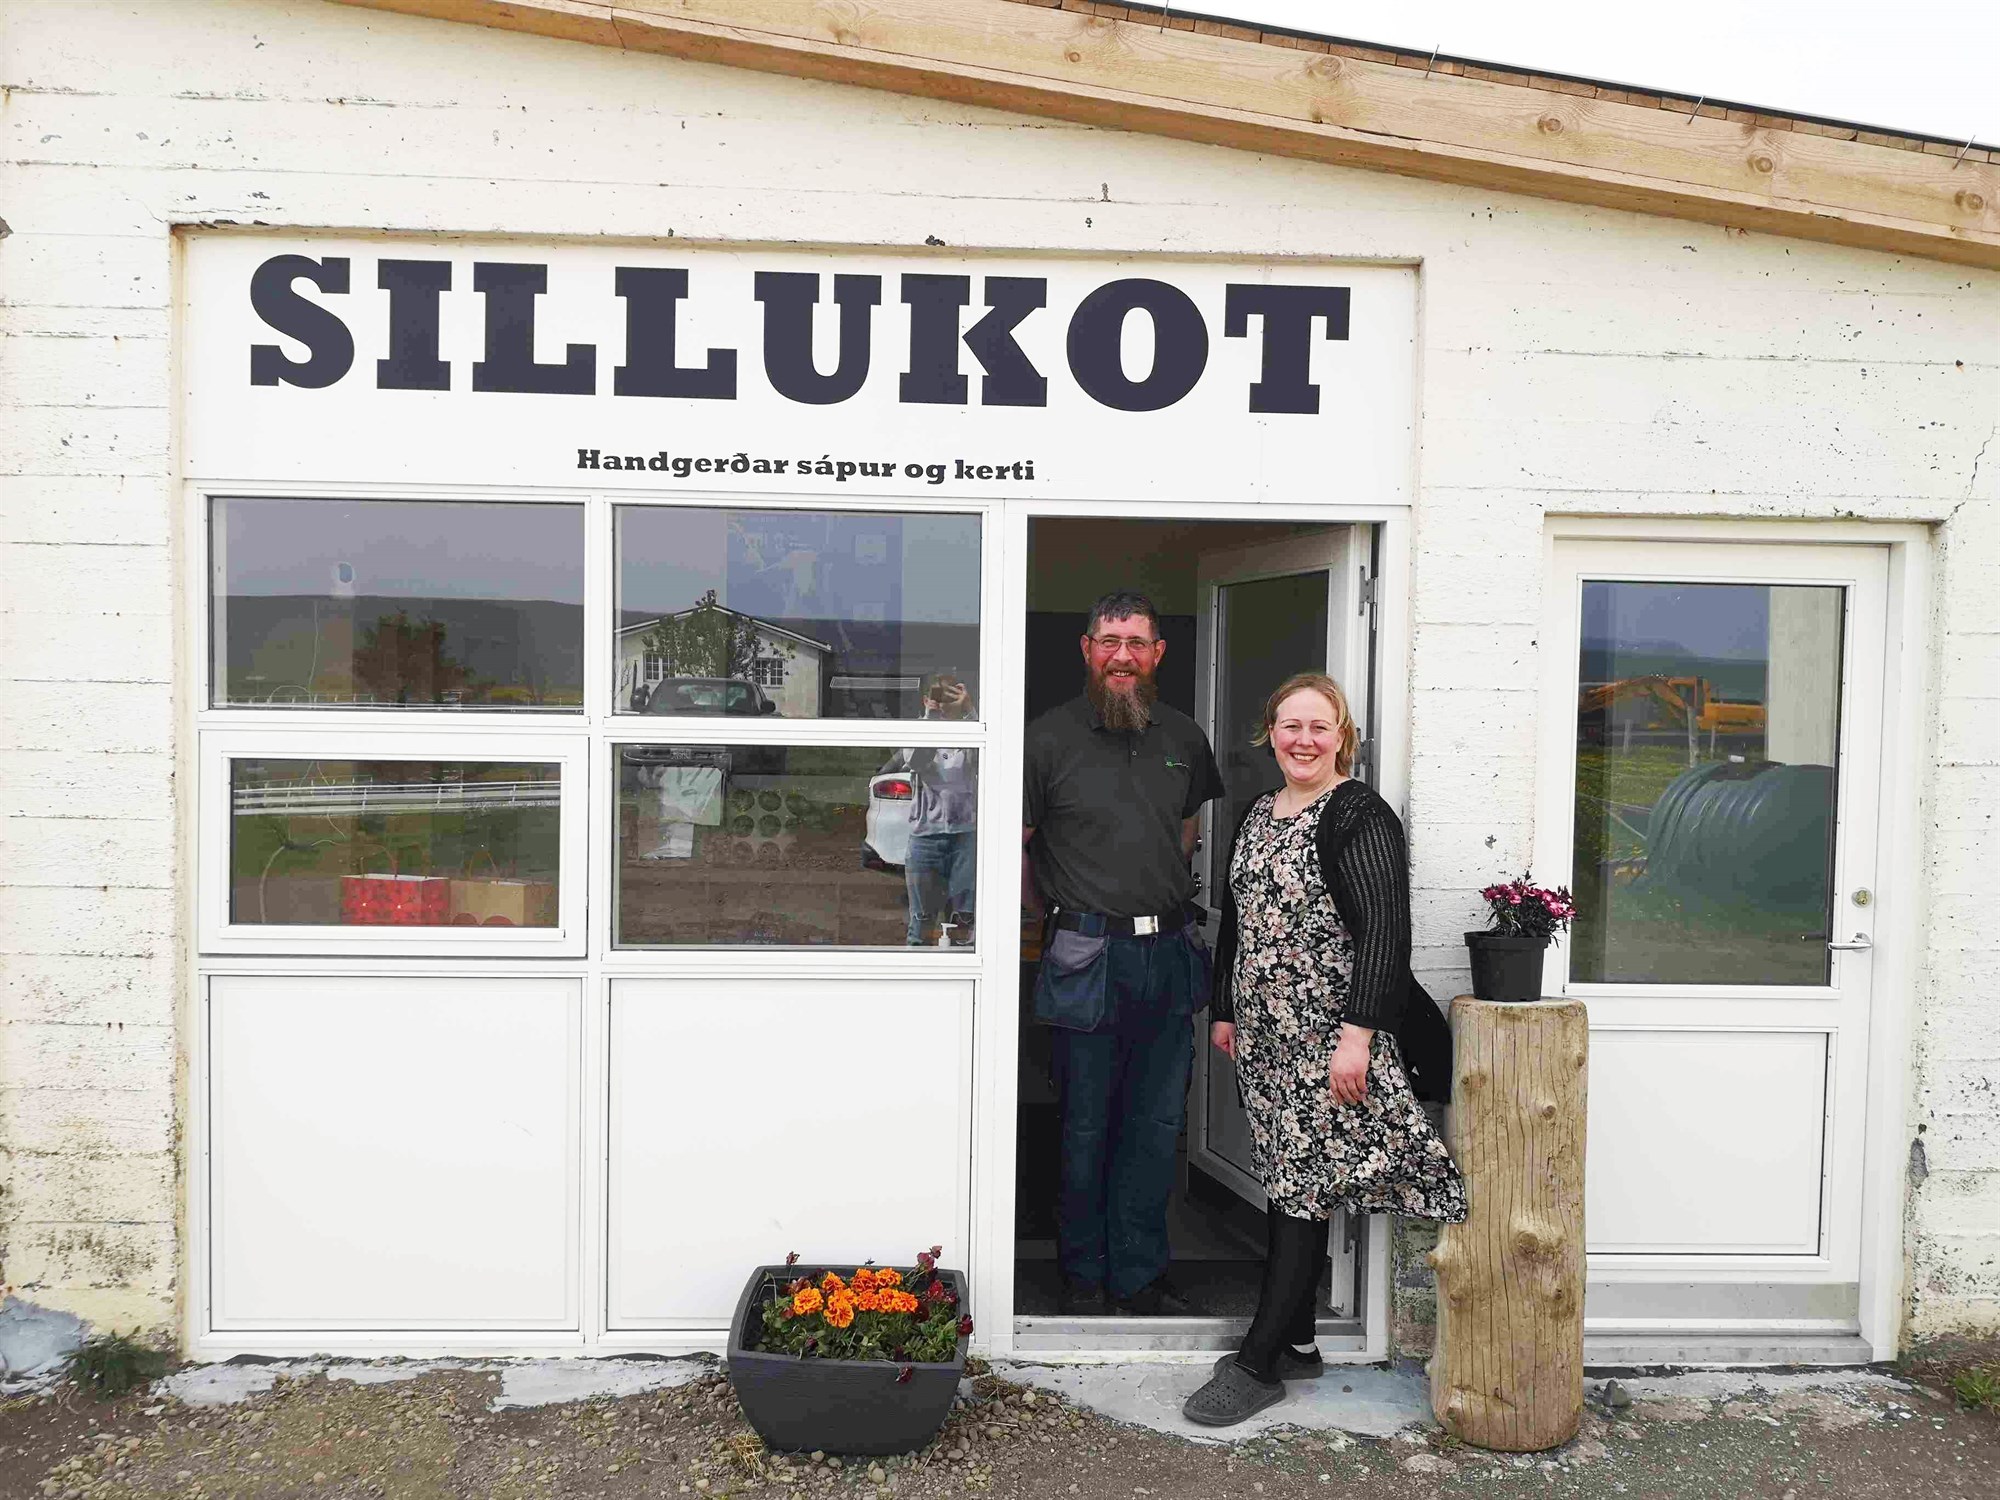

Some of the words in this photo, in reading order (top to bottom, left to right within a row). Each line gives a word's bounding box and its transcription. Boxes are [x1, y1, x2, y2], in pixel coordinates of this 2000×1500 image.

[250, 253, 1350, 414] SILLUKOT
[577, 448, 789, 478] Handgerðar
[797, 454, 897, 482] sápur
[904, 463, 947, 485] og
[954, 459, 1035, 481] kerti
